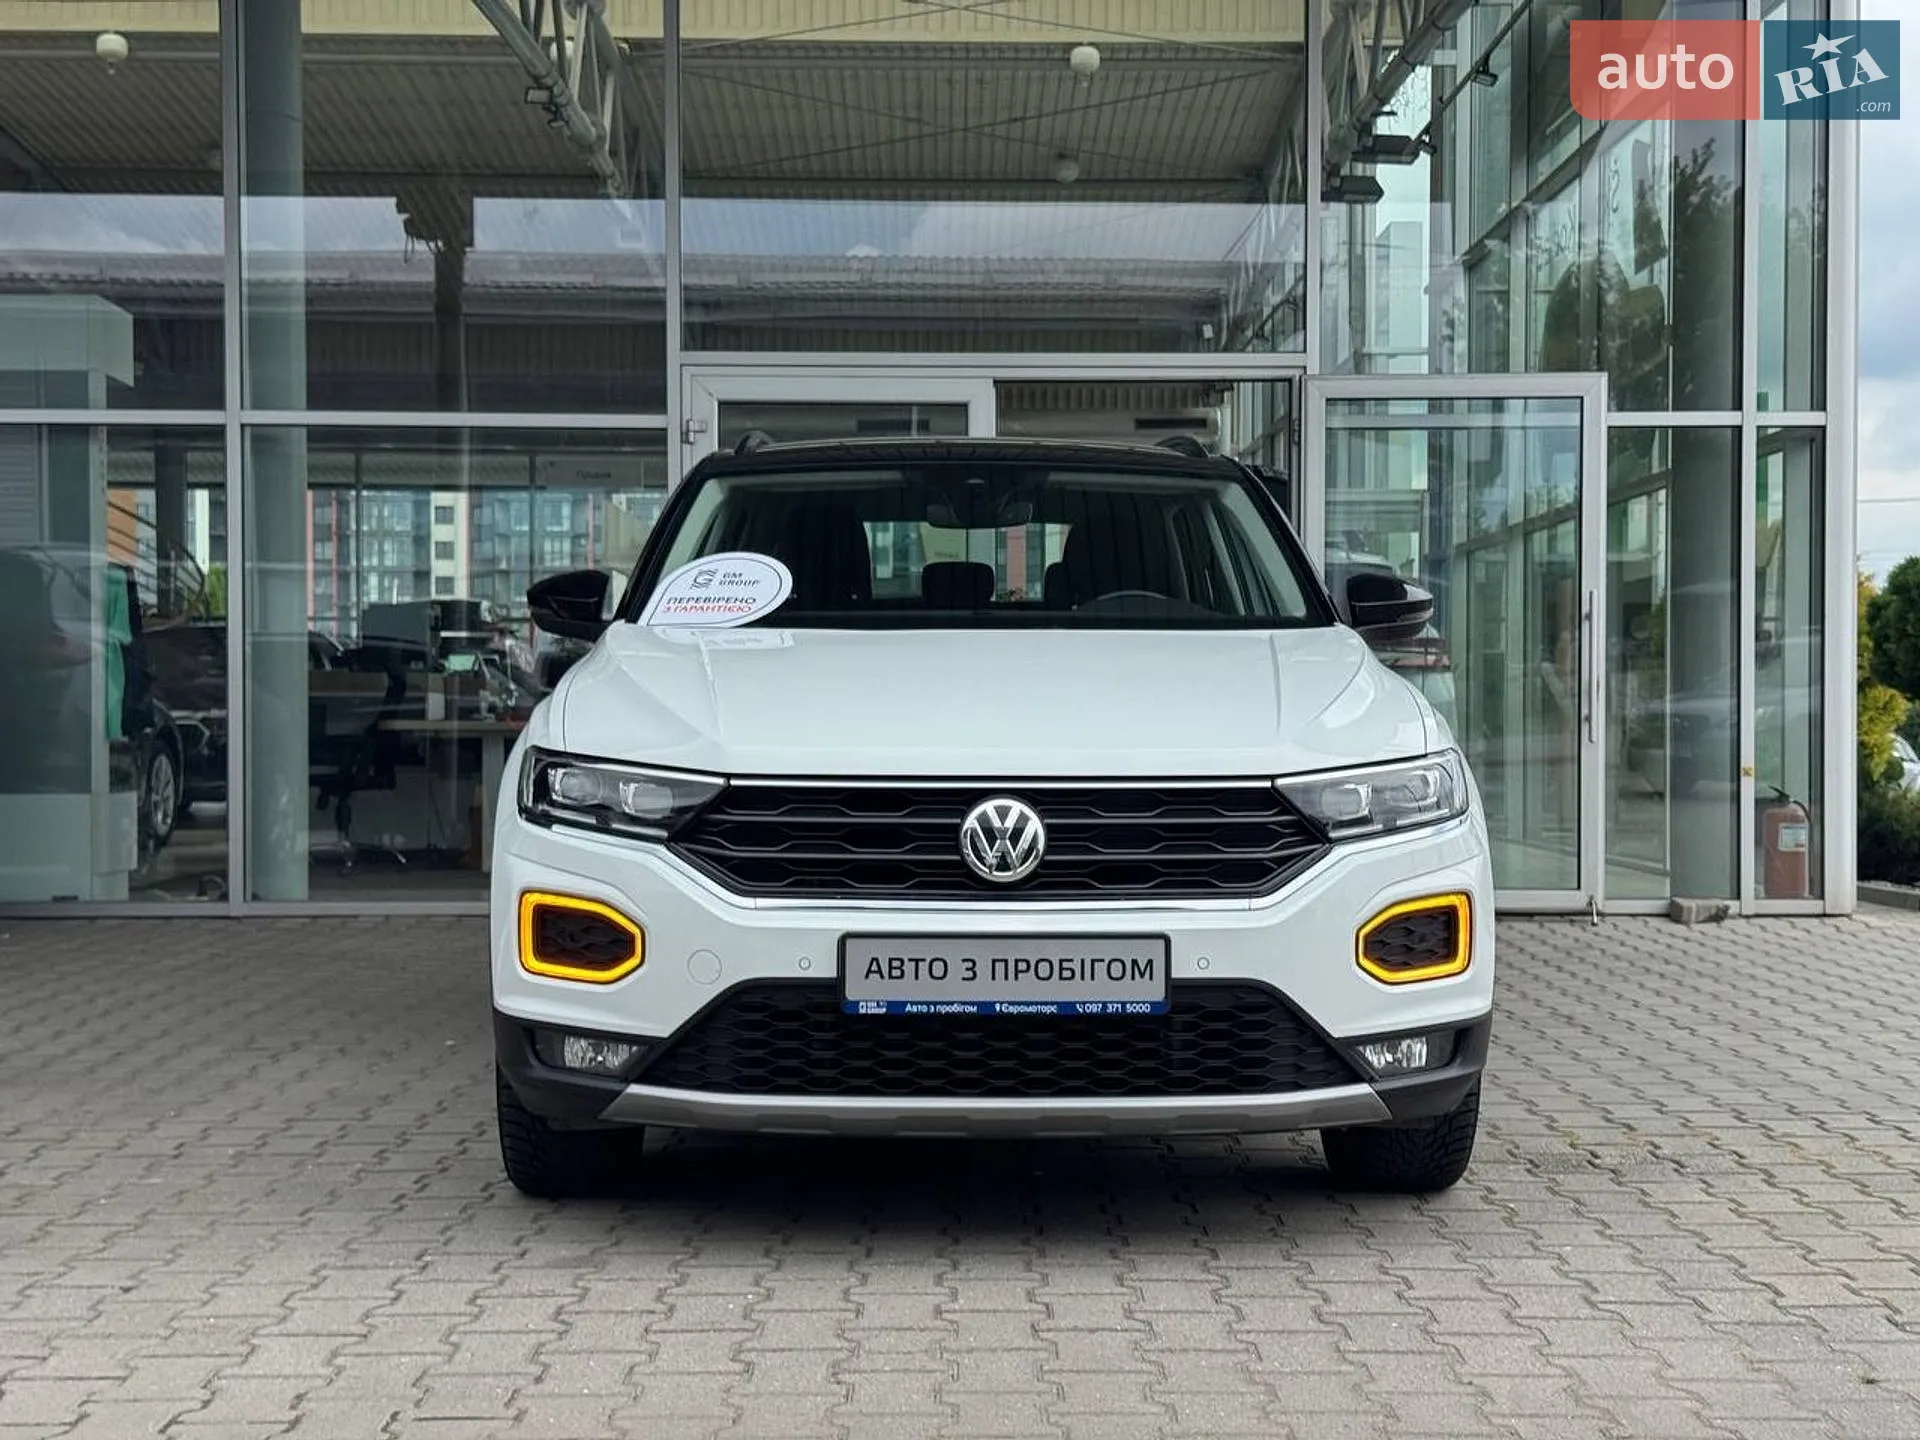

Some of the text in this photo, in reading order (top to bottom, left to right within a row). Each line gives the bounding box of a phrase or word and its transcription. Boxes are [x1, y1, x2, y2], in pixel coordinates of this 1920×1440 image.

[719, 579, 760, 587] GROUP
[666, 596, 756, 605] ПЕРЕВІРЕНО
[962, 798, 1045, 882] VW
[864, 957, 949, 981] АВТО
[991, 958, 1154, 981] ПРОБІГОМ
[905, 1002, 929, 1013] Авто
[936, 1003, 978, 1015] пробігом
[1084, 1003, 1151, 1013] 097 371 5000
